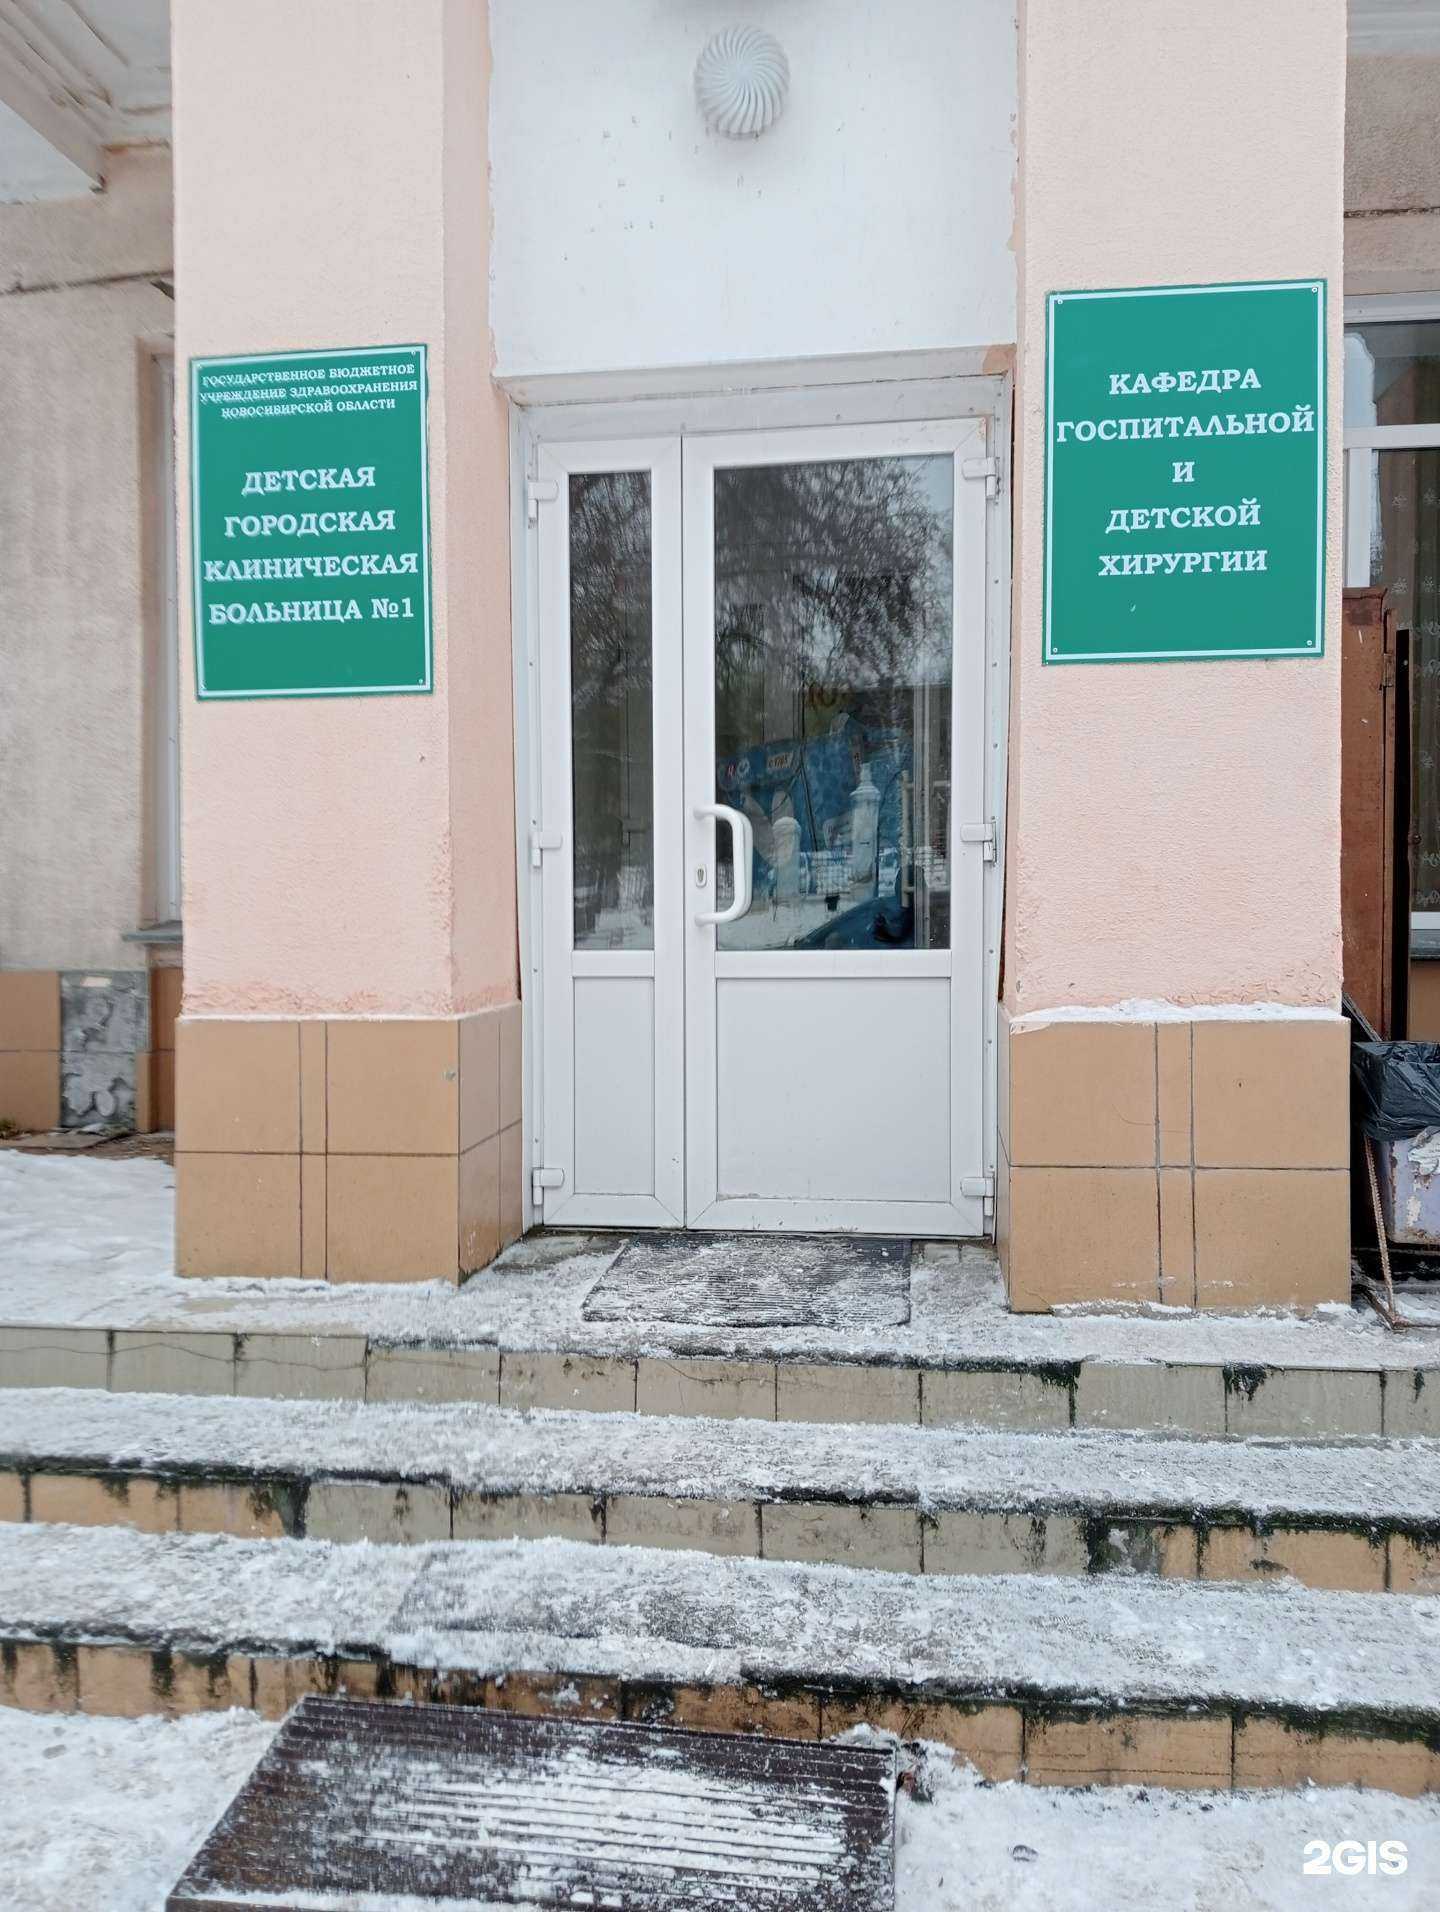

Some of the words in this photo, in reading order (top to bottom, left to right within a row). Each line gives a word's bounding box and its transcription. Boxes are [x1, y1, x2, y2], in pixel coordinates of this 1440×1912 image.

[202, 368, 325, 388] ГОСУДАРСТВЕННОЕ
[329, 364, 415, 380] БЮДЖЕТНОЕ
[1109, 368, 1261, 395] КАФЕДРА
[200, 388, 286, 404] УЧРЕЖДЕНИЕ
[289, 380, 418, 398] ЗДРАВООХРАНЕНИЯ
[221, 399, 333, 419] НОВОСИБИРСКОЙ
[336, 398, 396, 412] ОБЛАСТИ
[1056, 404, 1315, 442] ГОСПИТАЛЬНОЙ
[241, 466, 376, 496] ДЕТСКАЯ
[1172, 461, 1195, 483] И
[224, 510, 396, 538] ГОРОДСКАЯ
[1105, 497, 1261, 534] ДЕТСКОЙ
[203, 553, 418, 582] КЛИНИЧЕСКАЯ
[1098, 550, 1268, 577] ХИРУРГИИ
[208, 599, 363, 626] БОЛЬНИЦА
[371, 597, 414, 619] №1
